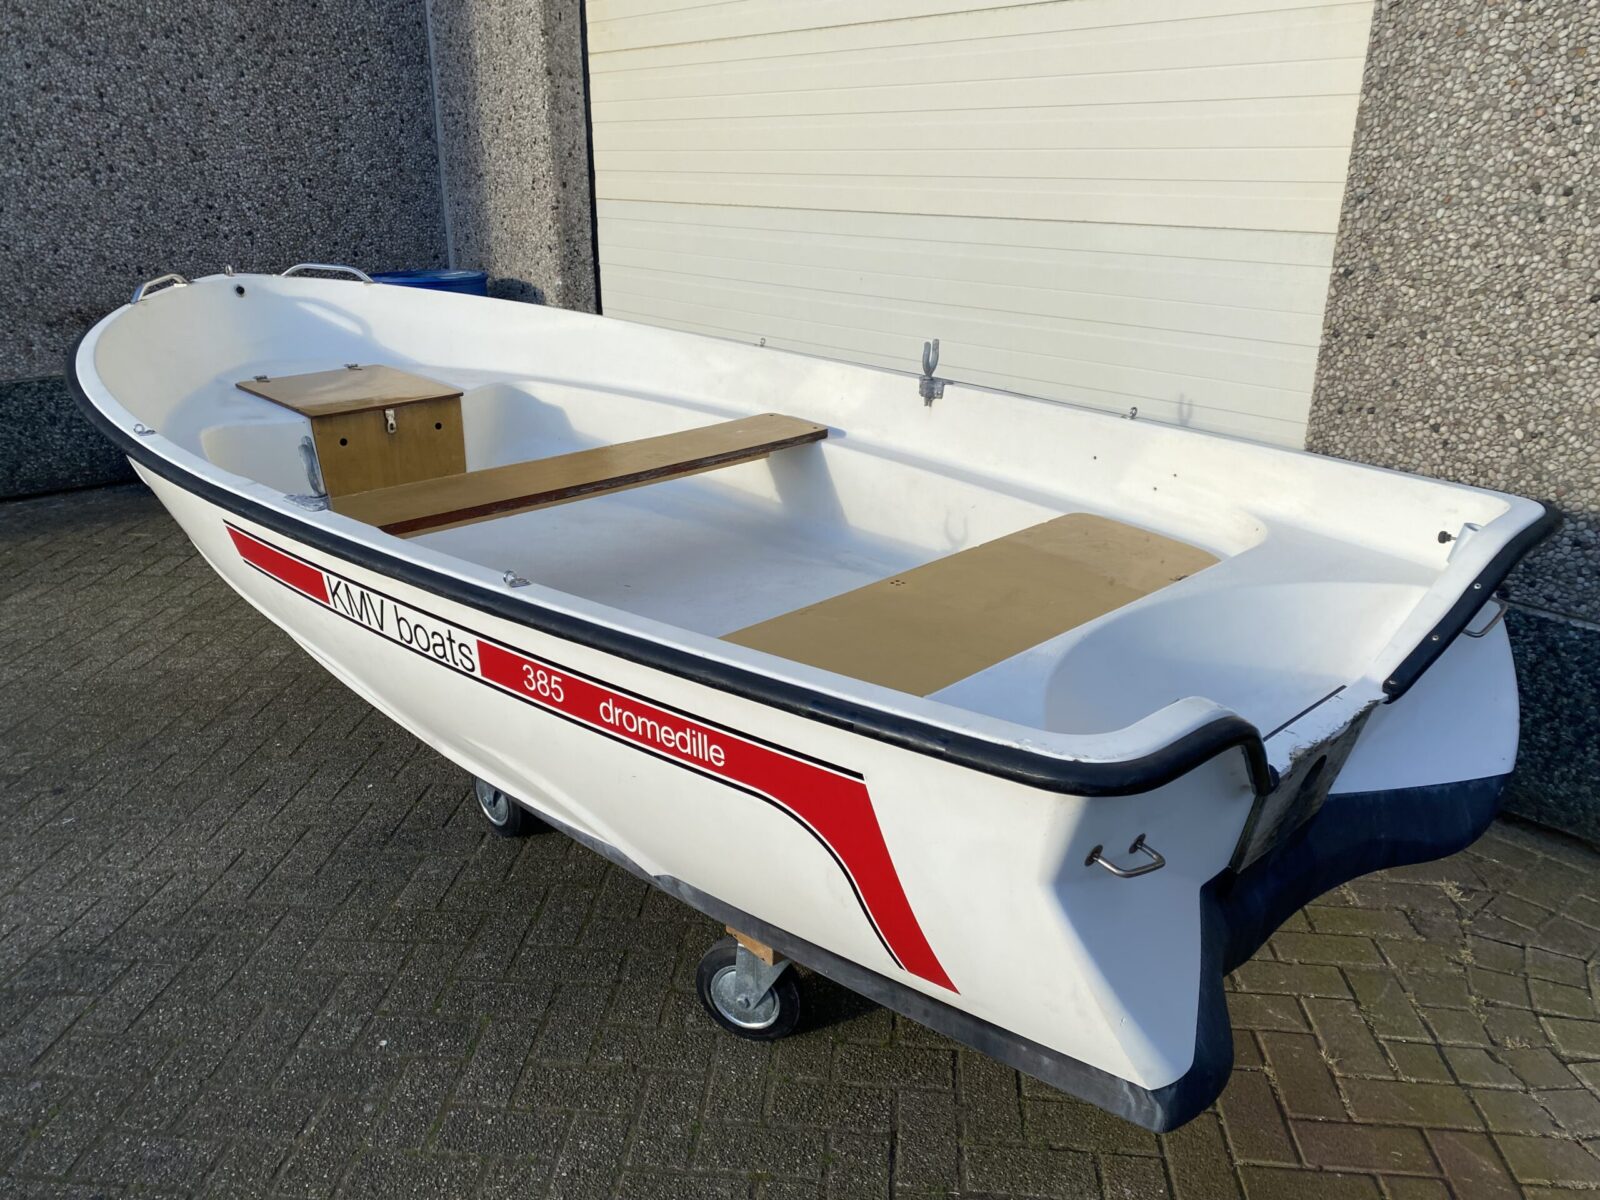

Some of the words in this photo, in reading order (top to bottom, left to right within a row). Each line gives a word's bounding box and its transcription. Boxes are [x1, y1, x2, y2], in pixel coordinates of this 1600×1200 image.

[326, 575, 384, 631] KMV
[393, 605, 475, 673] boats
[522, 664, 564, 703] 385
[599, 698, 726, 767] dromedille
